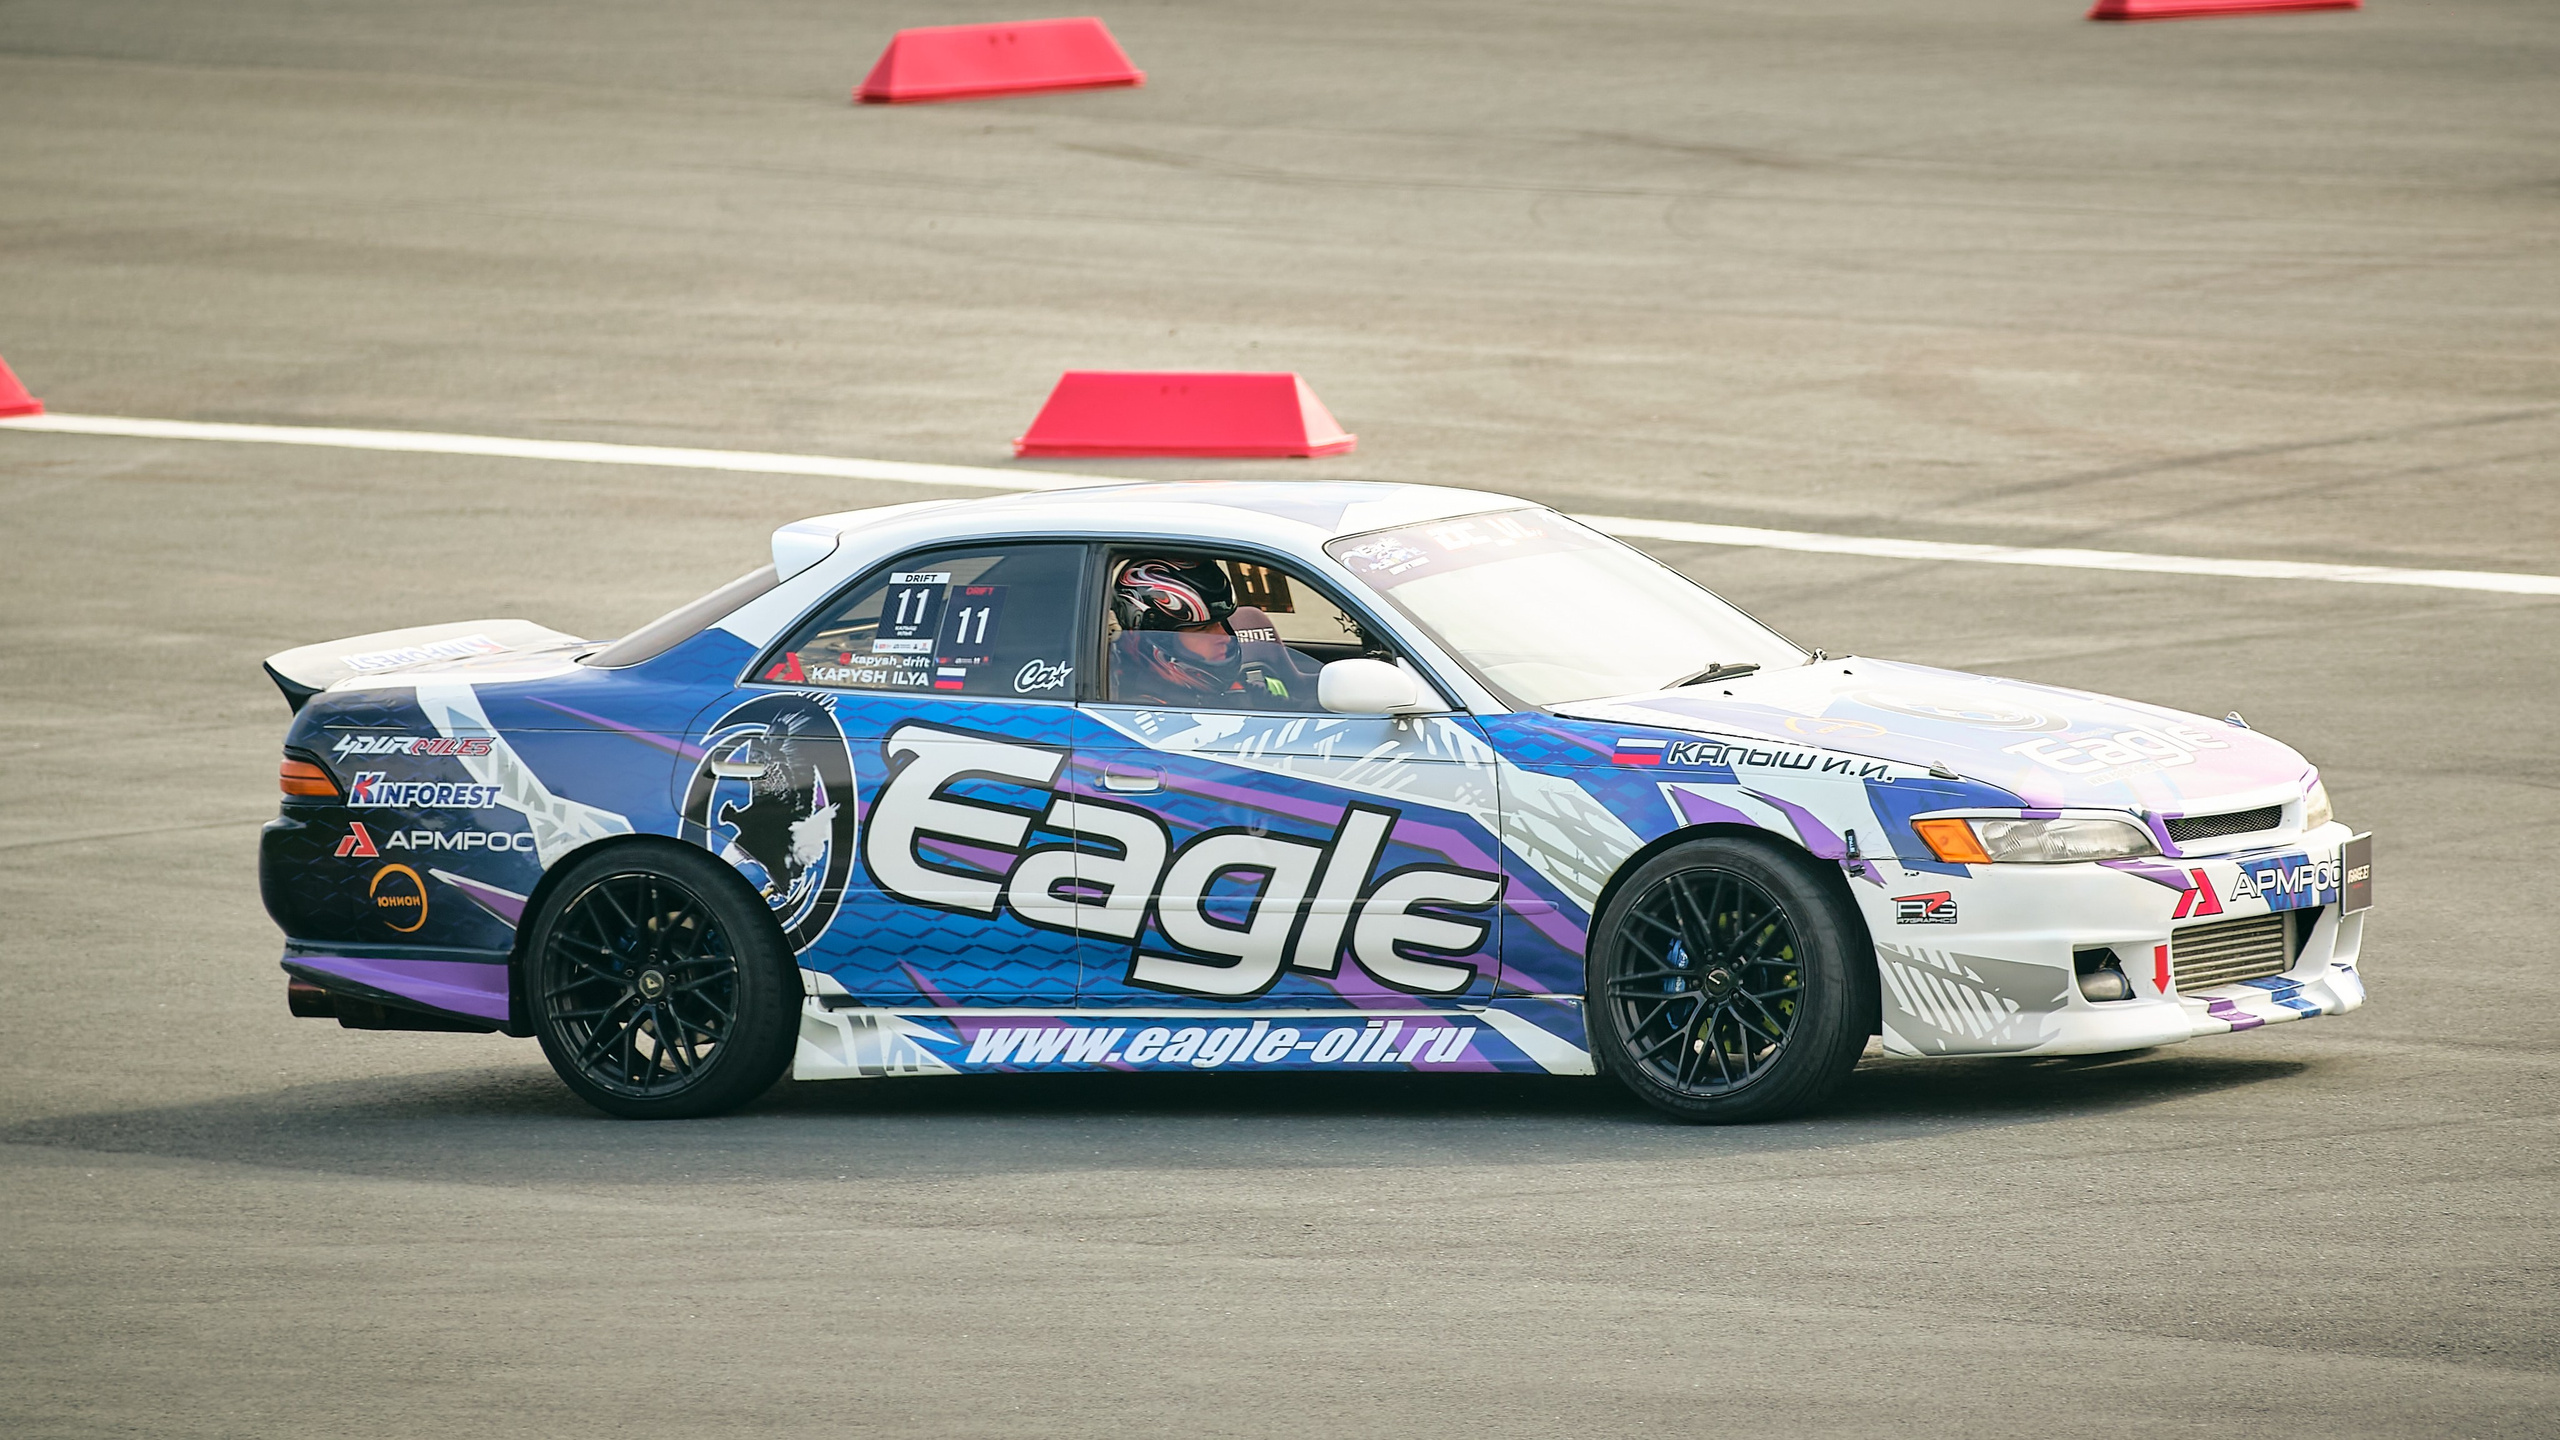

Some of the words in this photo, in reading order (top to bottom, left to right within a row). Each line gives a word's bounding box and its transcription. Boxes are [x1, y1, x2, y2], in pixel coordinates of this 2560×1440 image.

[905, 574, 938, 583] DRIFT
[895, 588, 930, 625] 11
[956, 607, 991, 644] 11
[811, 667, 886, 684] KAPYSH
[891, 671, 929, 686] ILYA
[1669, 741, 1818, 770] КАПЫШ
[2000, 723, 2231, 774] Eagle
[348, 772, 503, 808] KINFOREST
[861, 718, 1509, 997] Eagle
[377, 895, 421, 907] ЮНИОН
[965, 1020, 1478, 1069] www.eagle-oil.ru
